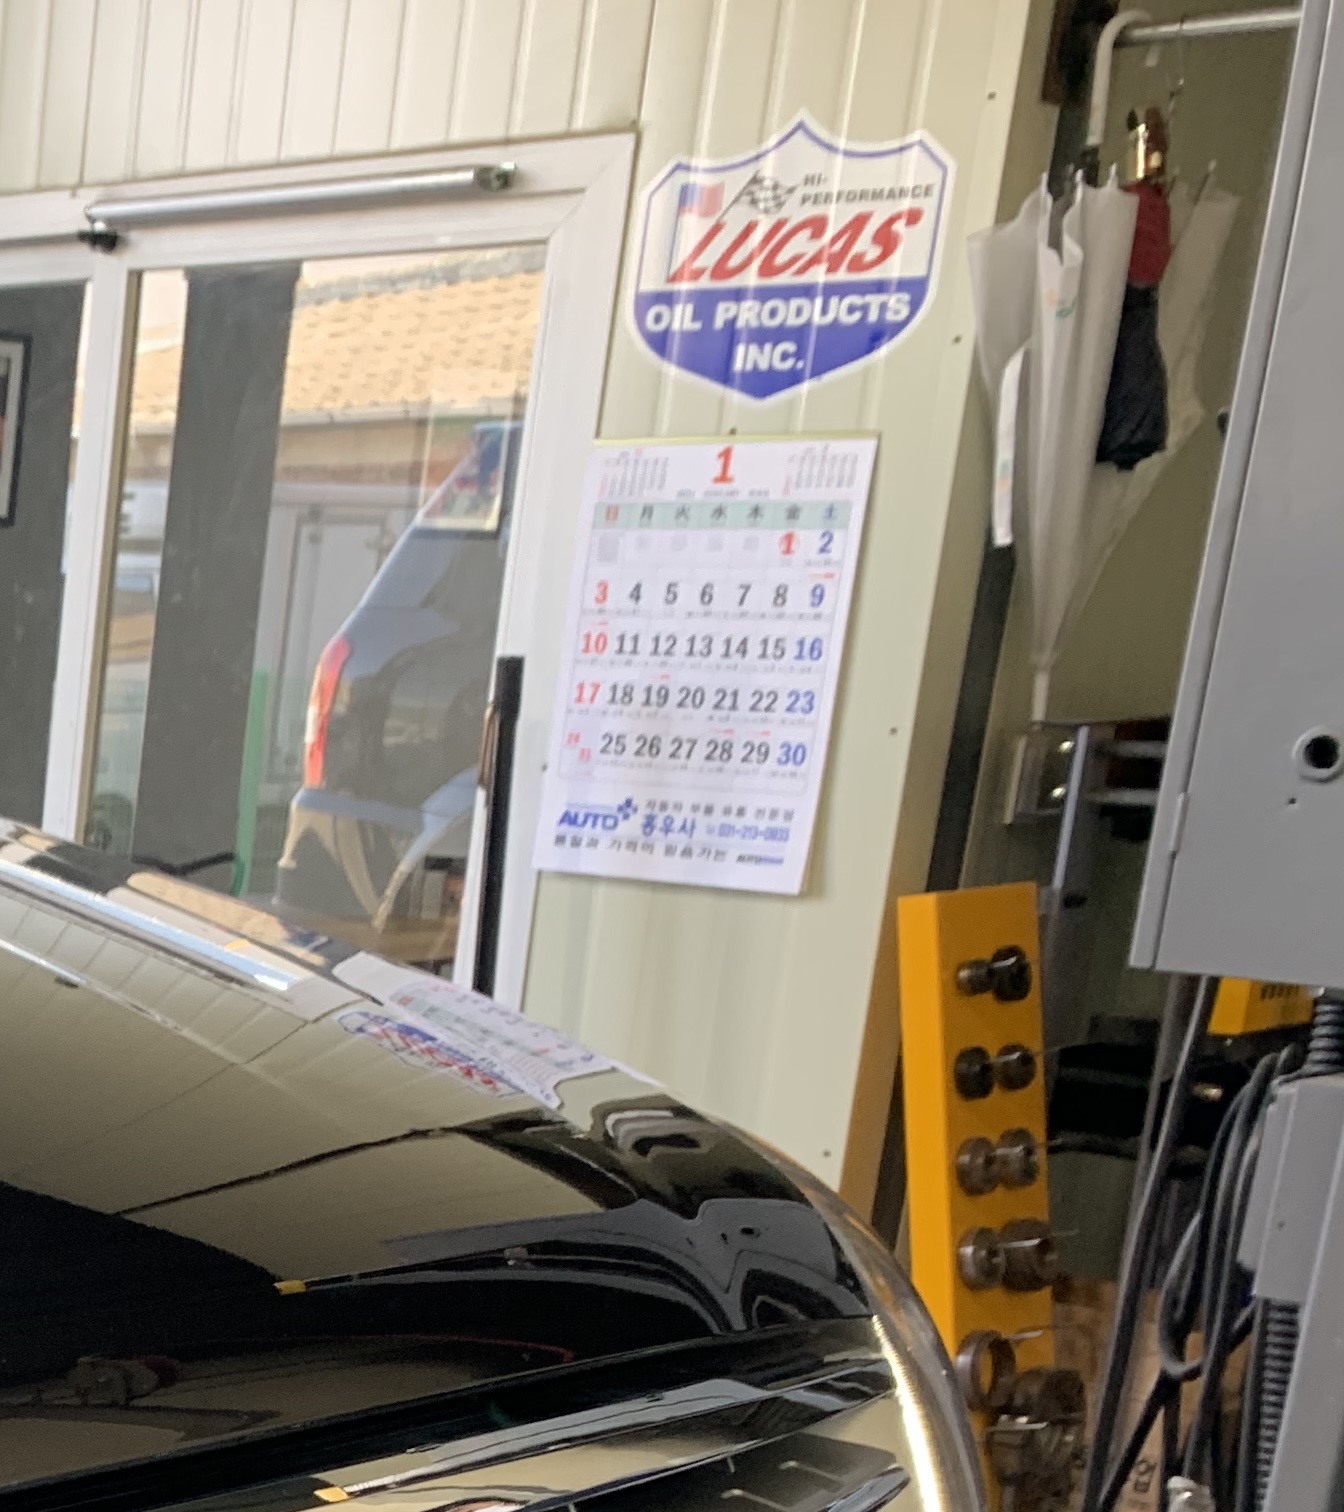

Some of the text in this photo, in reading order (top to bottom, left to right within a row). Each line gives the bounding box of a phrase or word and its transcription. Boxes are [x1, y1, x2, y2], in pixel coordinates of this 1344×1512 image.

[800, 184, 933, 206] PERFORMANCE
[666, 207, 925, 283] LUCAS
[645, 291, 912, 332] OIL PRODUCTS
[733, 341, 804, 373] INC.
[712, 445, 736, 484] 1
[779, 530, 834, 556] 1 2
[594, 580, 825, 608] 3 4 5 6 7 8 9
[581, 630, 608, 654] 10
[615, 631, 640, 656] 11
[650, 633, 678, 657] 12
[685, 634, 714, 658] 13
[720, 635, 748, 659] 14
[758, 636, 786, 660] 15
[574, 680, 816, 715] 17 18 19 20 21 22 23
[599, 732, 627, 755] 25
[634, 734, 662, 758] 26
[669, 736, 698, 760] 27
[704, 738, 734, 762] 28
[741, 740, 771, 764] 29
[777, 742, 807, 766] 30
[558, 809, 619, 831] AUTO
